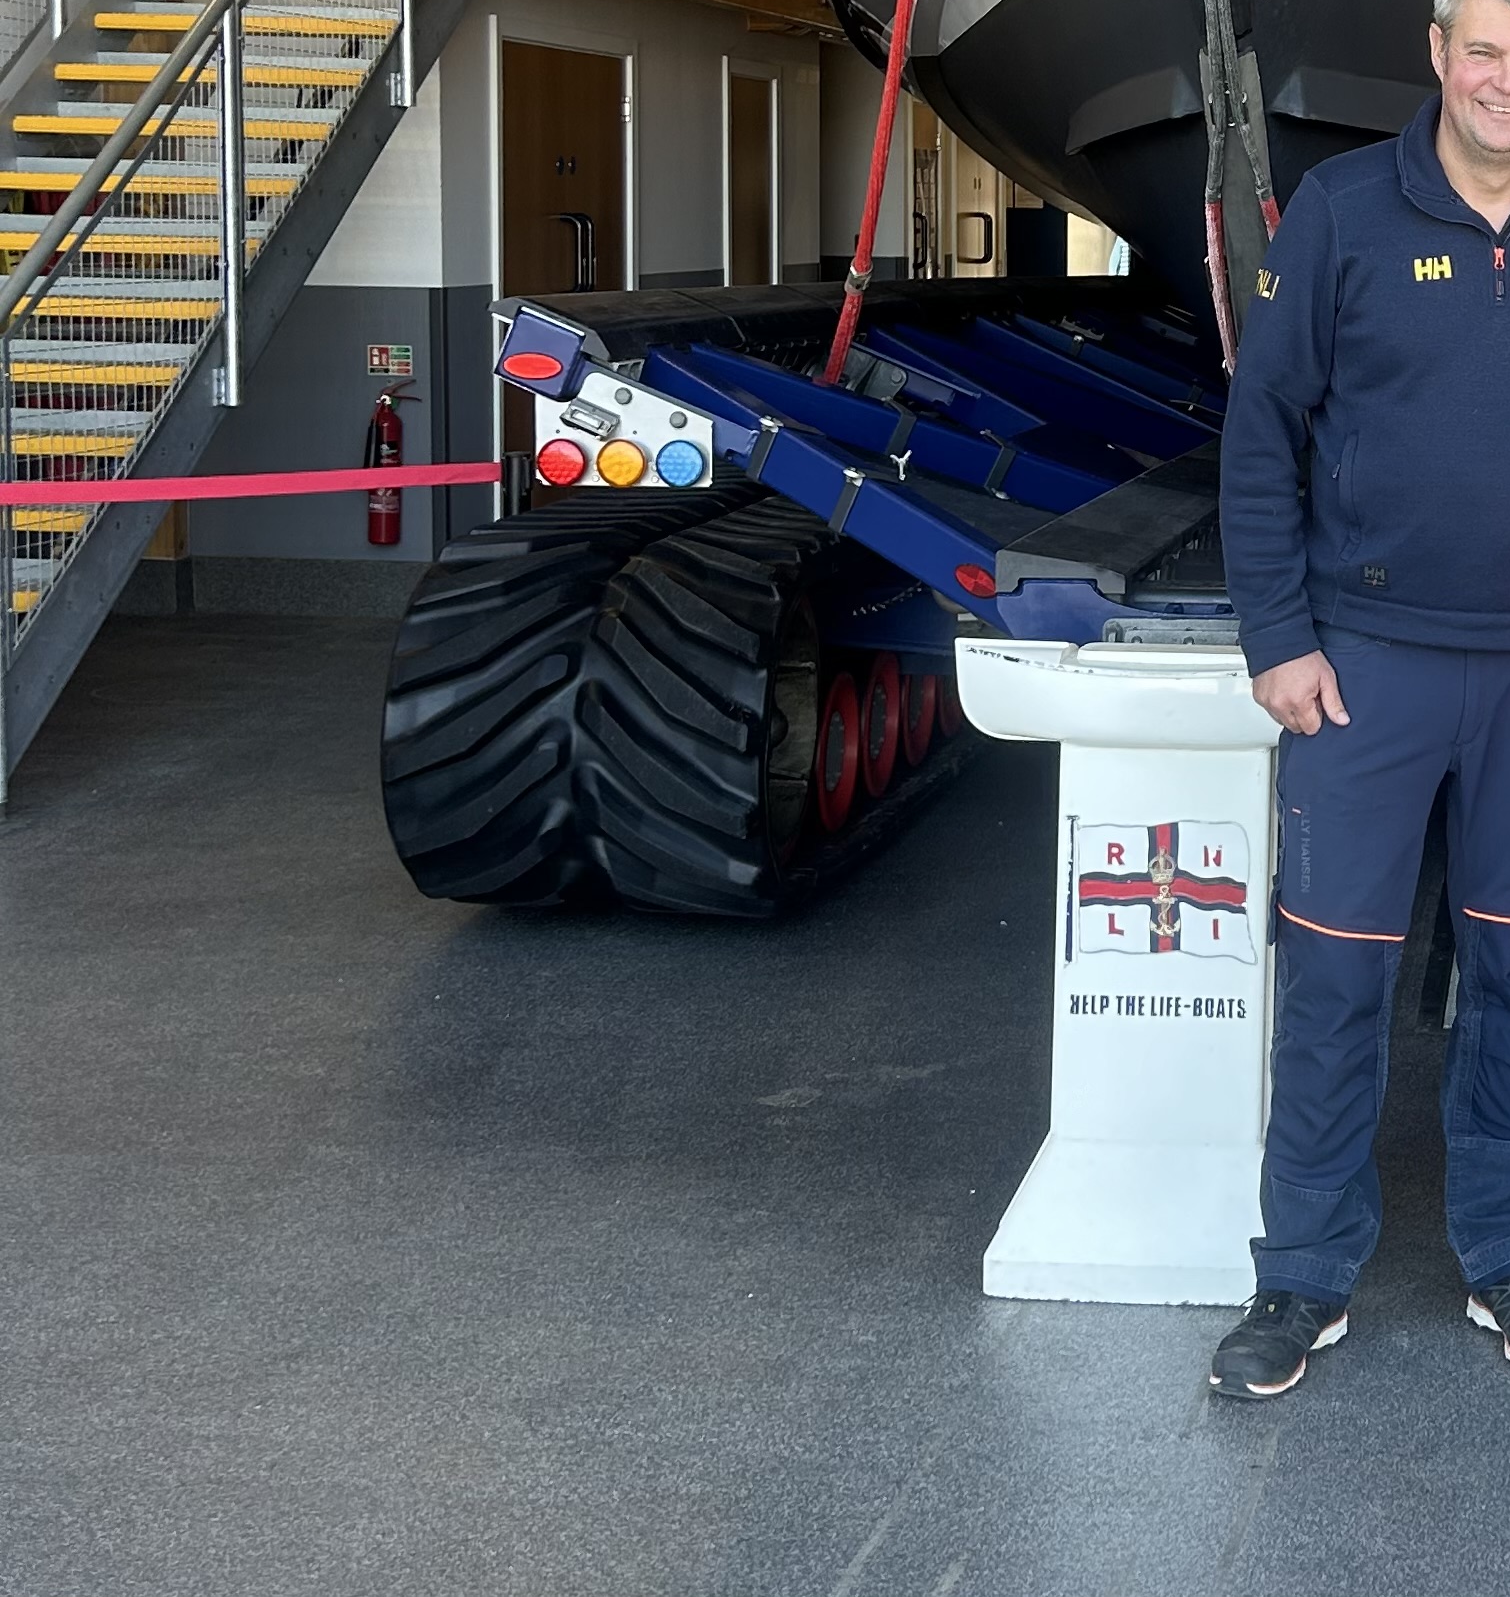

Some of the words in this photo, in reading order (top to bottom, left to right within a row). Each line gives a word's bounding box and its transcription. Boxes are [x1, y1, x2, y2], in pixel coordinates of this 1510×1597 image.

[1413, 255, 1453, 282] HH
[1255, 268, 1281, 301] NLI
[1107, 842, 1126, 866] R
[1107, 912, 1125, 937] L
[1070, 994, 1110, 1015] HELP
[1116, 995, 1146, 1017] THE
[1150, 995, 1248, 1019] LIFE-BOATS
